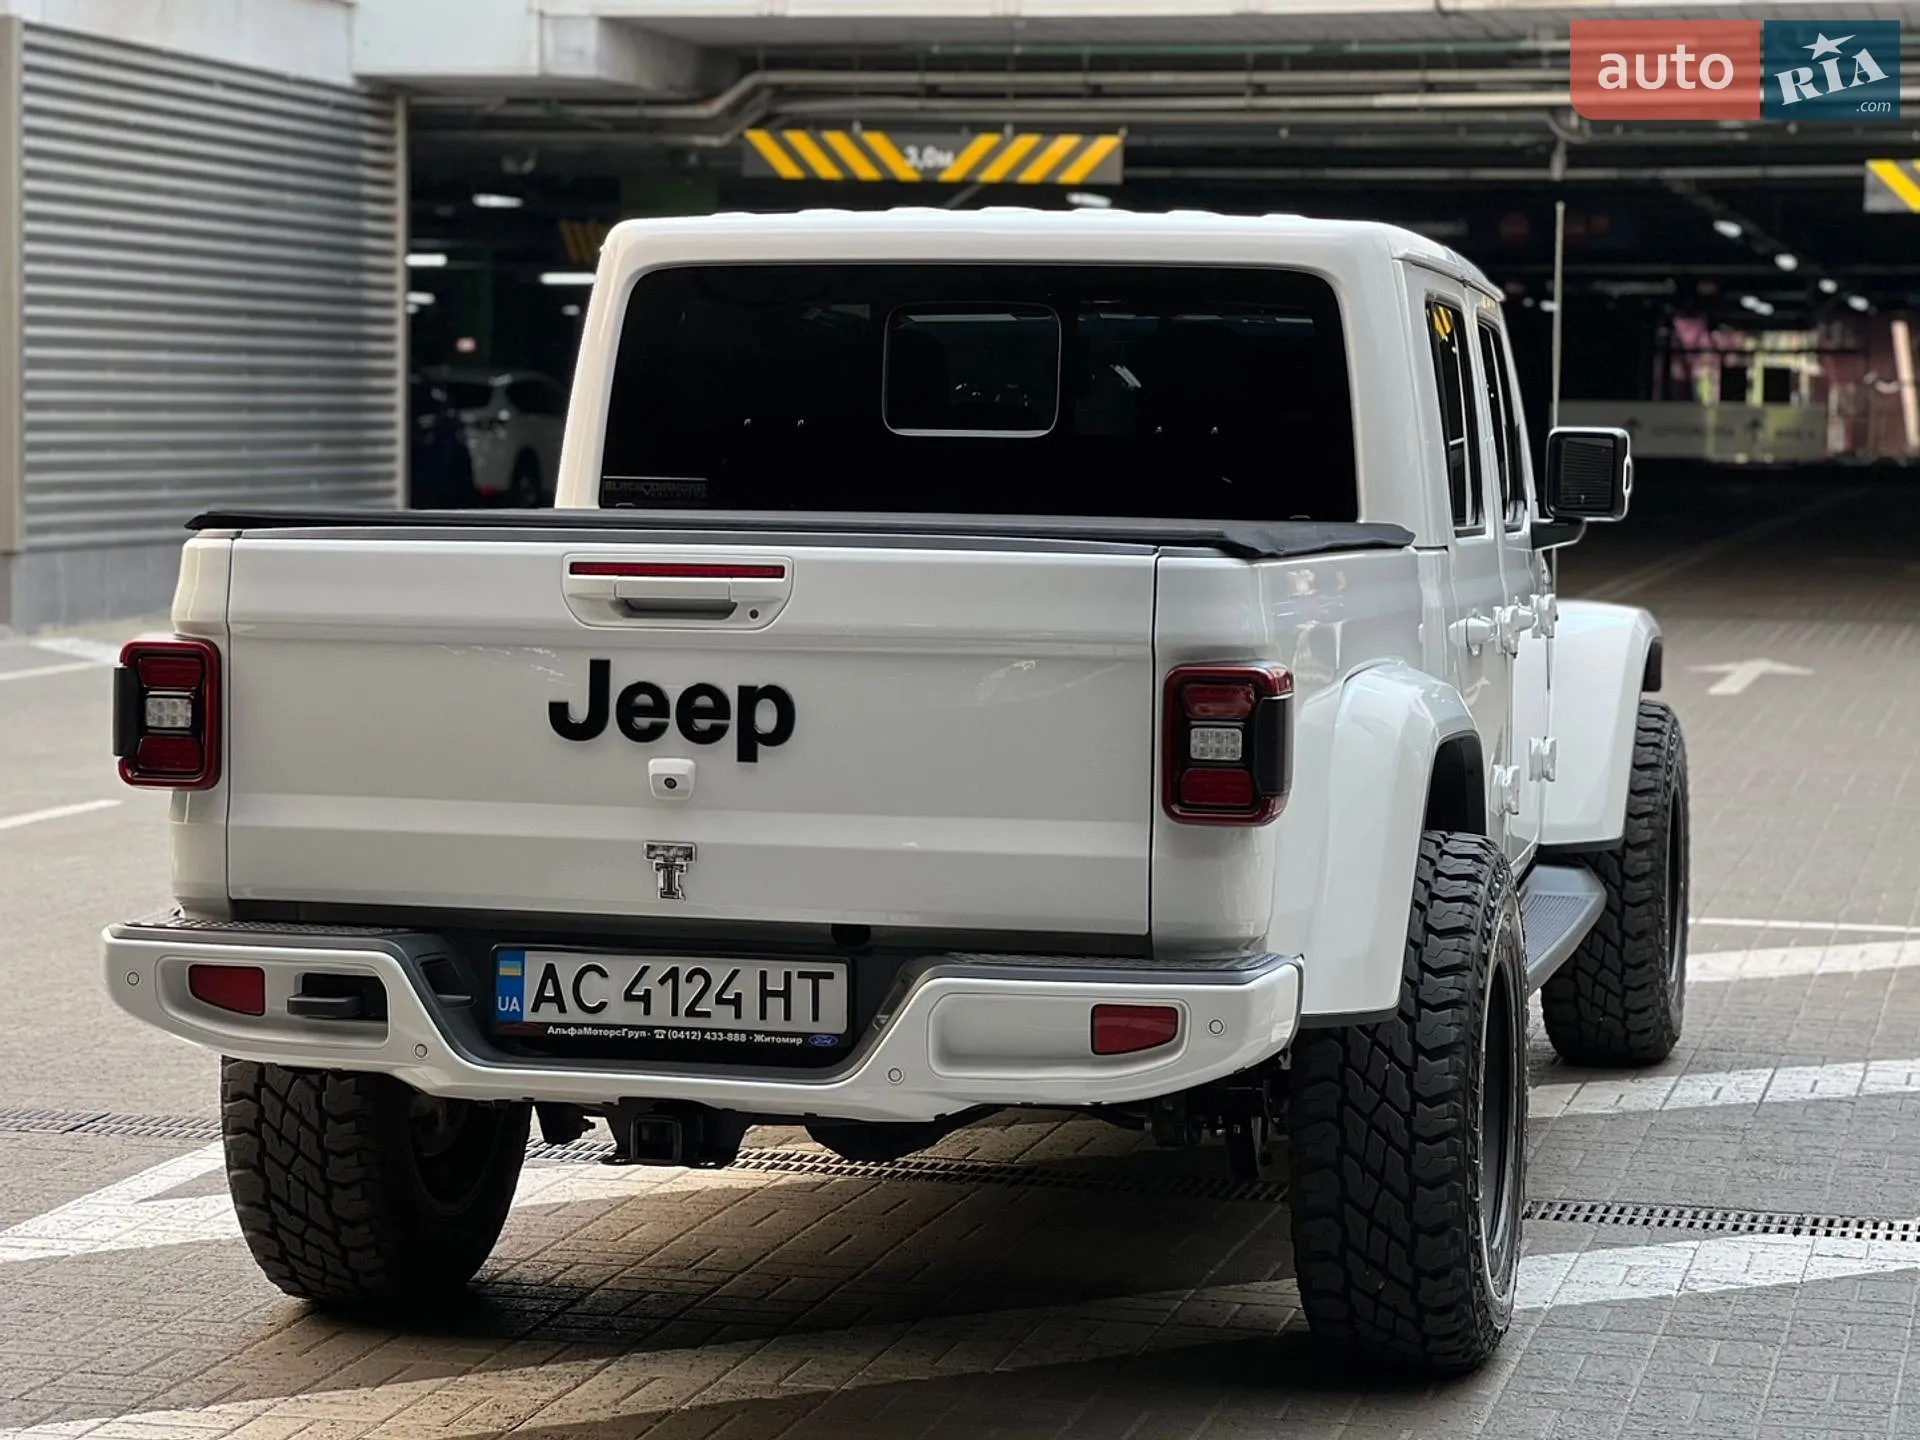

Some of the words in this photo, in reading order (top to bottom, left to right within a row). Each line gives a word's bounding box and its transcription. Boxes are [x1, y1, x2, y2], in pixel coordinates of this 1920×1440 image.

[548, 659, 795, 763] Jeep
[497, 996, 521, 1013] UA
[530, 962, 609, 1014] AC
[623, 965, 743, 1019] 4124
[759, 970, 835, 1022] HT
[668, 1029, 702, 1041] (0412)
[704, 1031, 747, 1043] 433-888
[753, 1033, 803, 1046] Житомир
